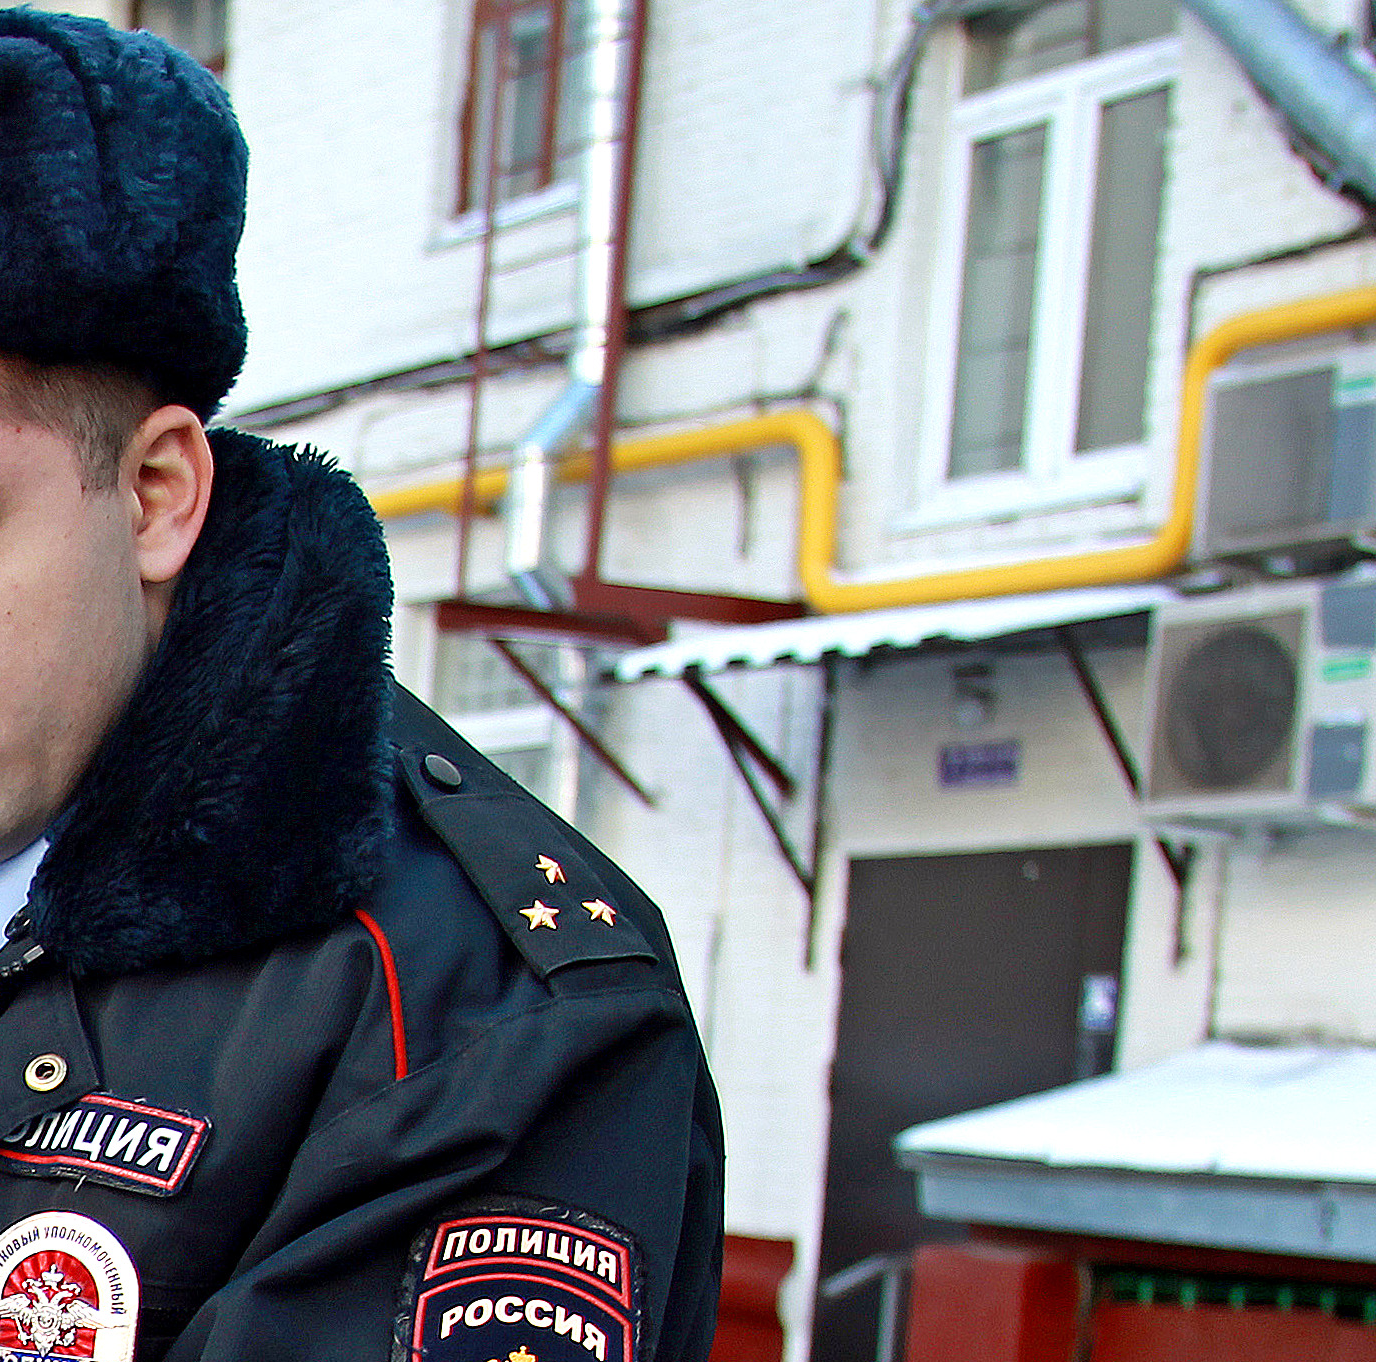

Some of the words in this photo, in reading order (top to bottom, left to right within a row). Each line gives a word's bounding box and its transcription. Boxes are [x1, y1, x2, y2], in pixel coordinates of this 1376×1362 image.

[2, 1109, 184, 1173] ЛИЦИЯ
[44, 1225, 127, 1315] УПОЛНОМОЧЕННЫЙ
[442, 1227, 618, 1284] ПОЛИЦИЯ
[440, 1296, 607, 1362] РОССИЯ
